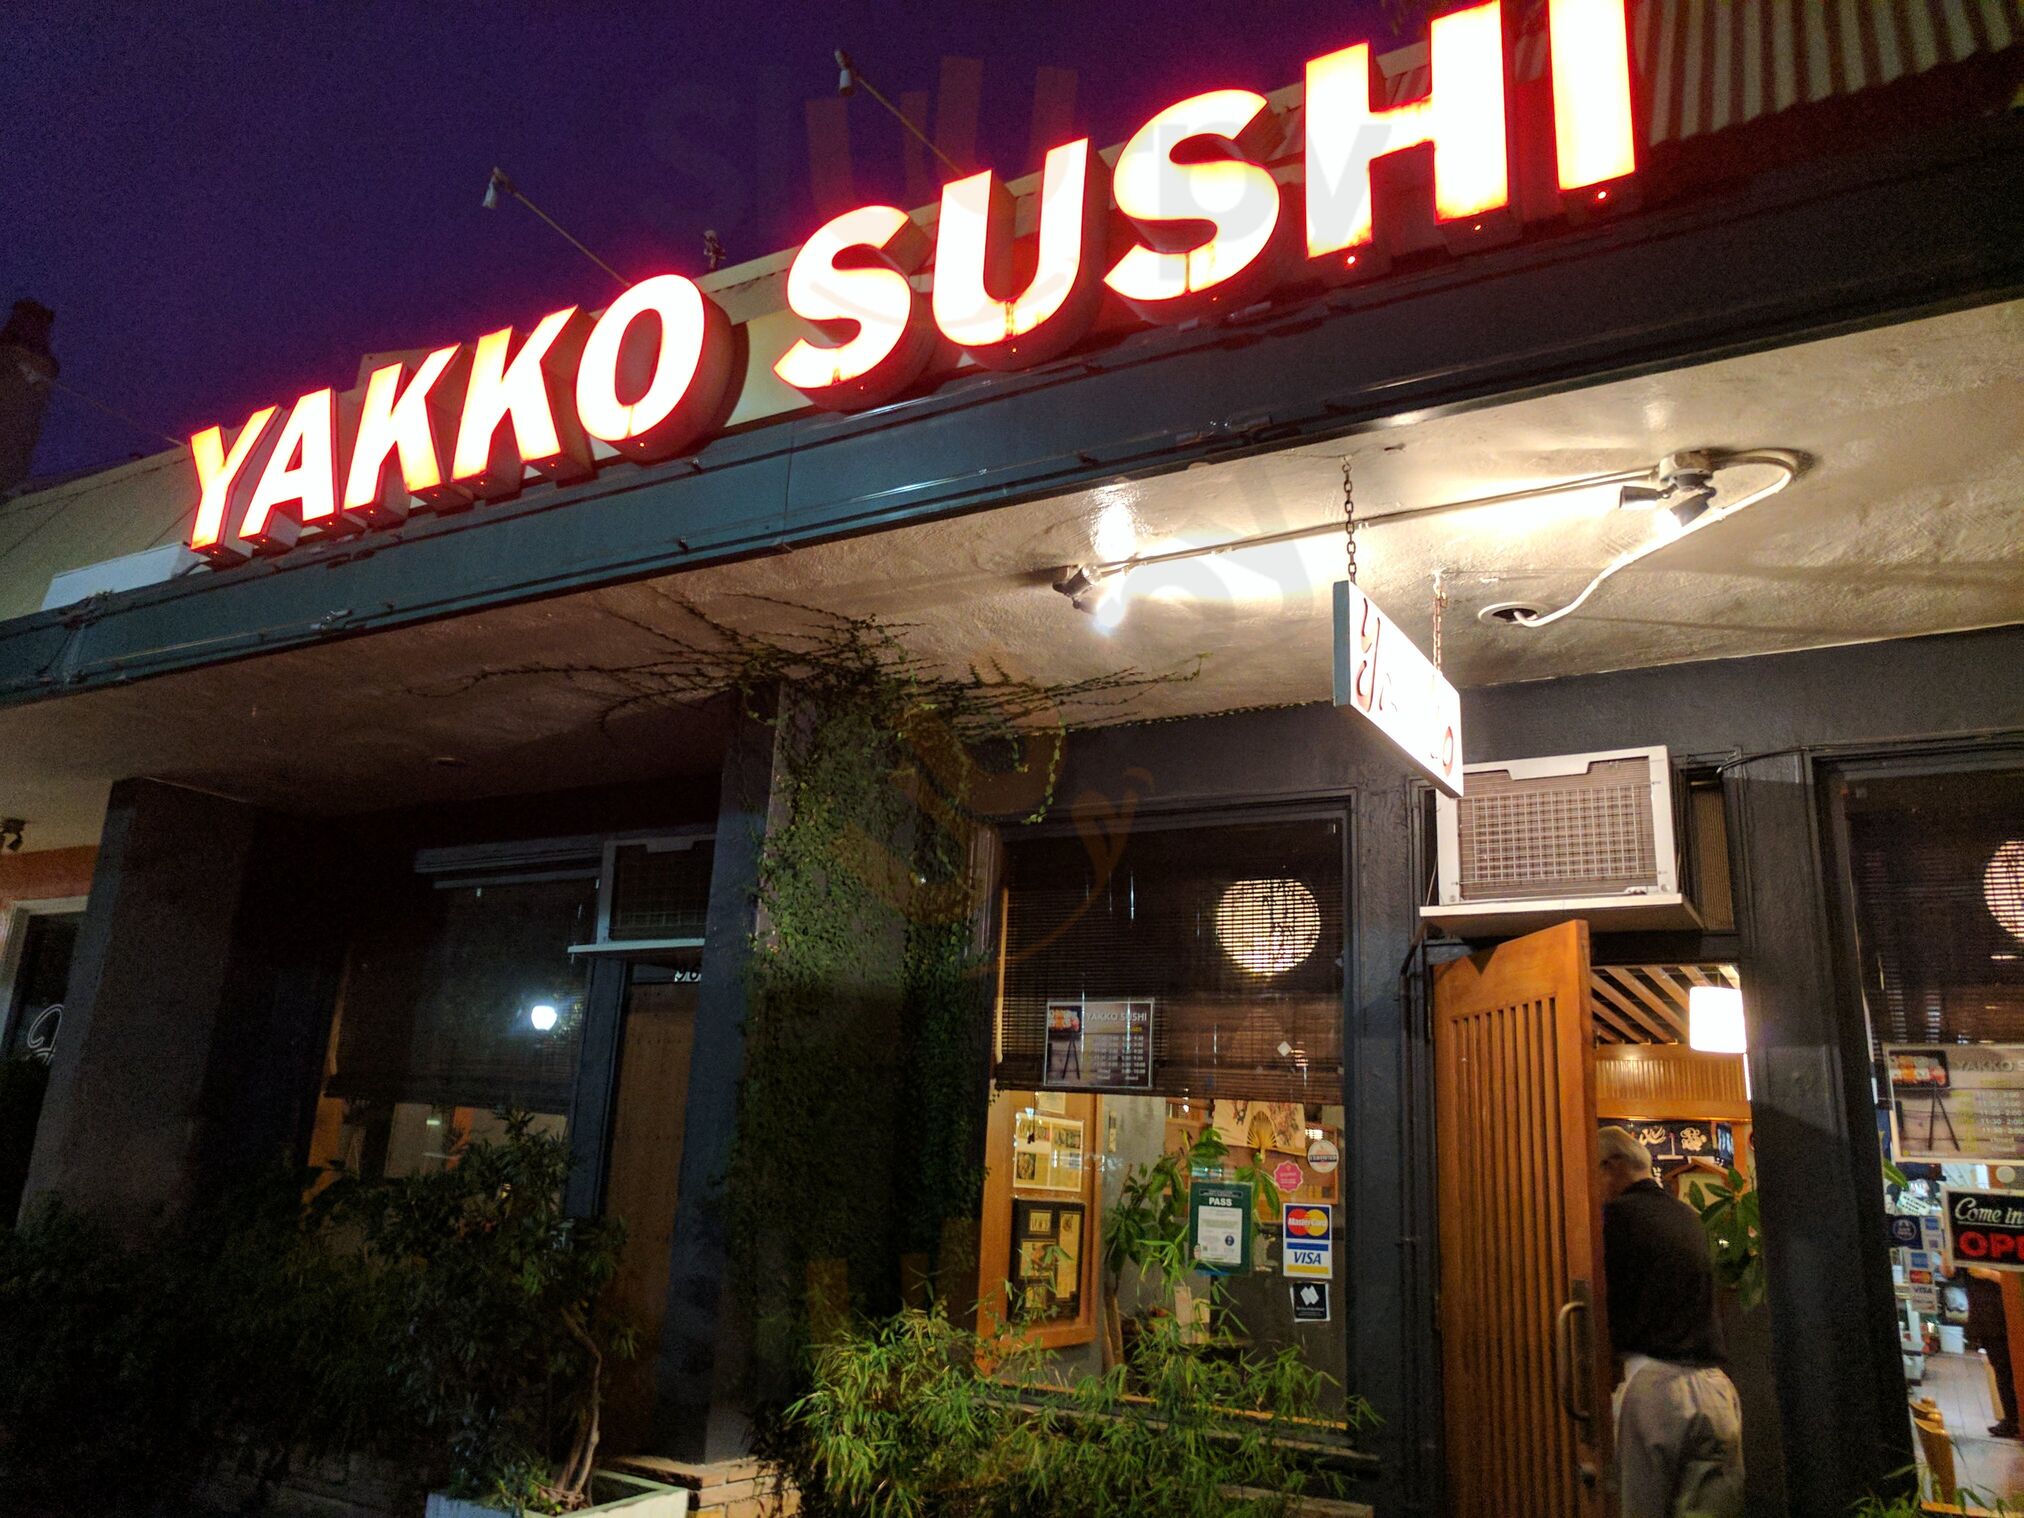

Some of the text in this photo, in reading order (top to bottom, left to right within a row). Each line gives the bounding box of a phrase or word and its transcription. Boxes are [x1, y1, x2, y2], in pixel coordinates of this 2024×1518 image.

[189, 0, 1636, 552] YAKKO SUSHI
[1208, 1197, 1232, 1206] PASS
[1954, 1197, 2003, 1223] Come
[1287, 1216, 1328, 1228] MasterCard
[1293, 1251, 1322, 1265] VISA
